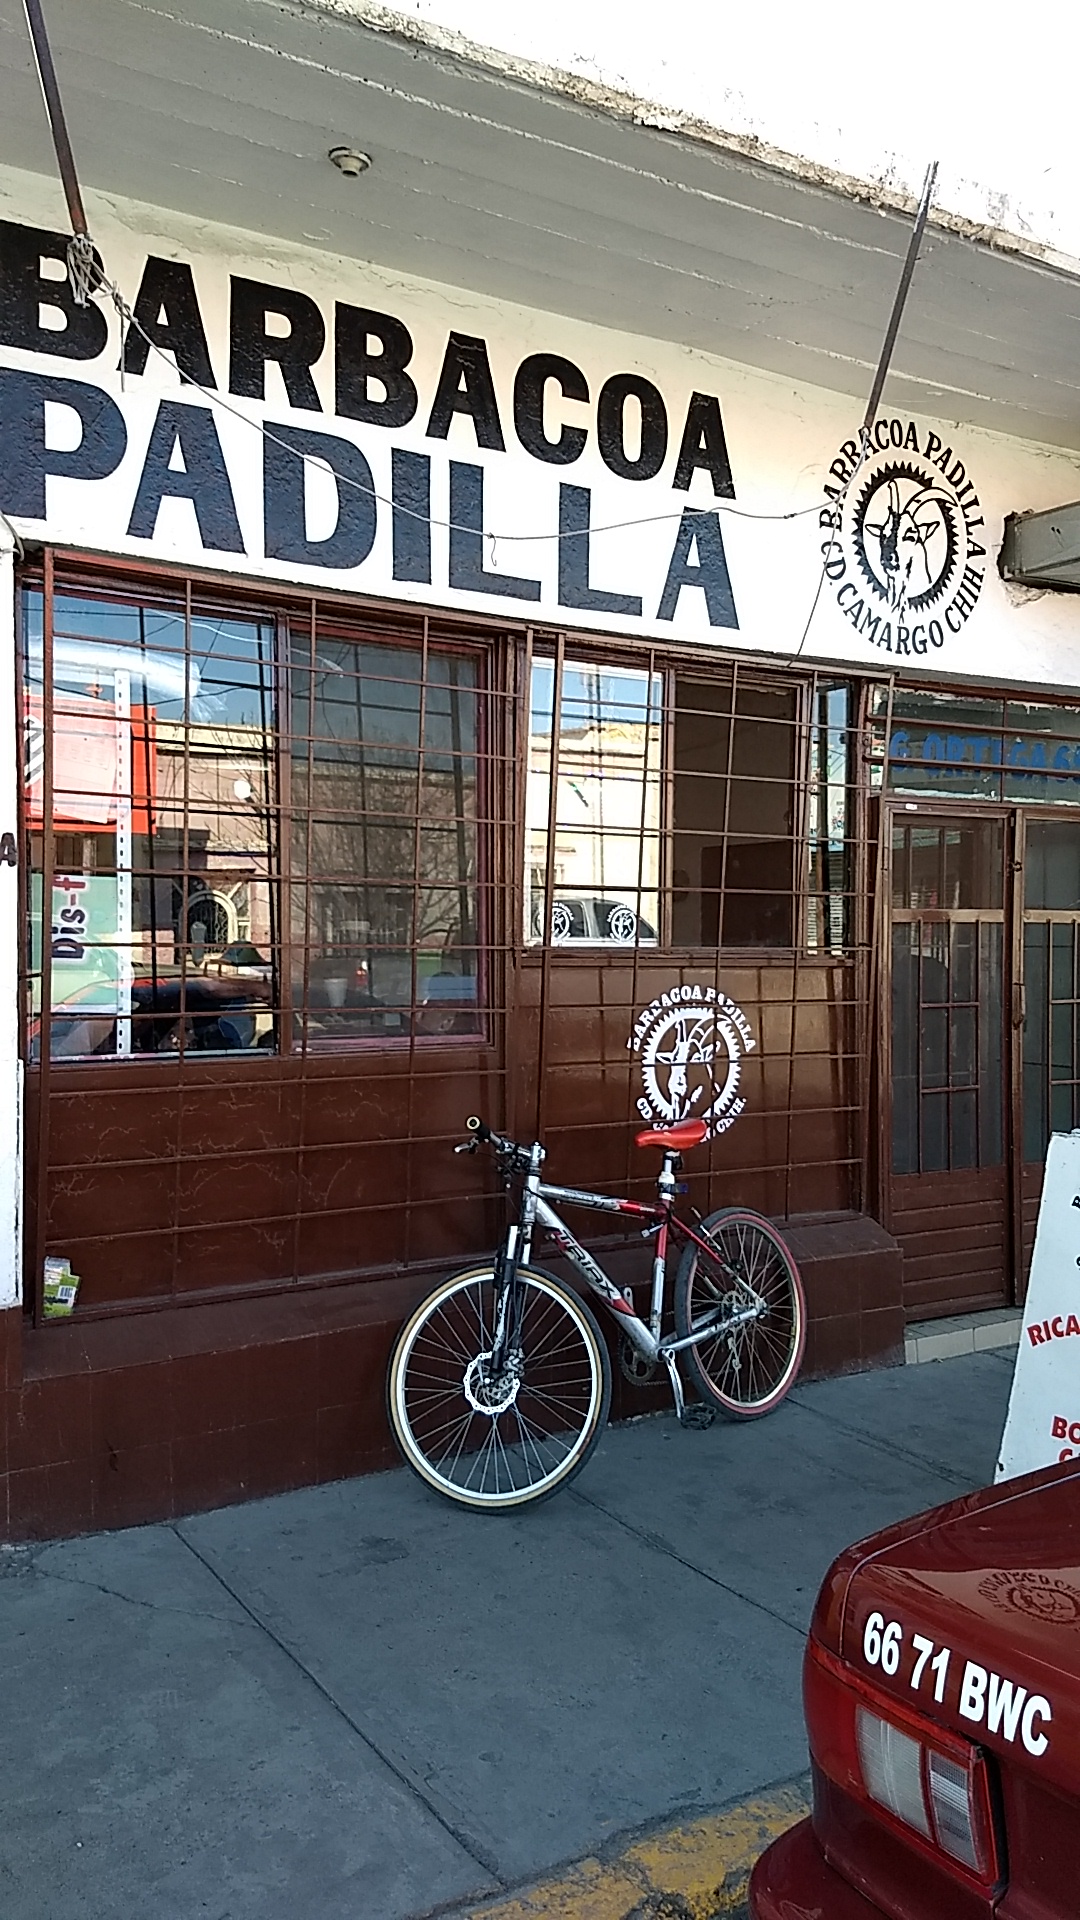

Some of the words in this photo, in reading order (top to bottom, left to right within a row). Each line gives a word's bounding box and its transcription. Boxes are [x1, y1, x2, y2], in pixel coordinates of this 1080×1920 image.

[0, 220, 736, 500] BARBACOA
[0, 366, 740, 630] PADILLA
[923, 431, 986, 559] PADILLA
[837, 583, 944, 656] CAMARGO
[705, 988, 756, 1052] PADILLA
[863, 1612, 903, 1676] 66
[911, 1634, 951, 1703] 71
[959, 1661, 1053, 1757] BWC
